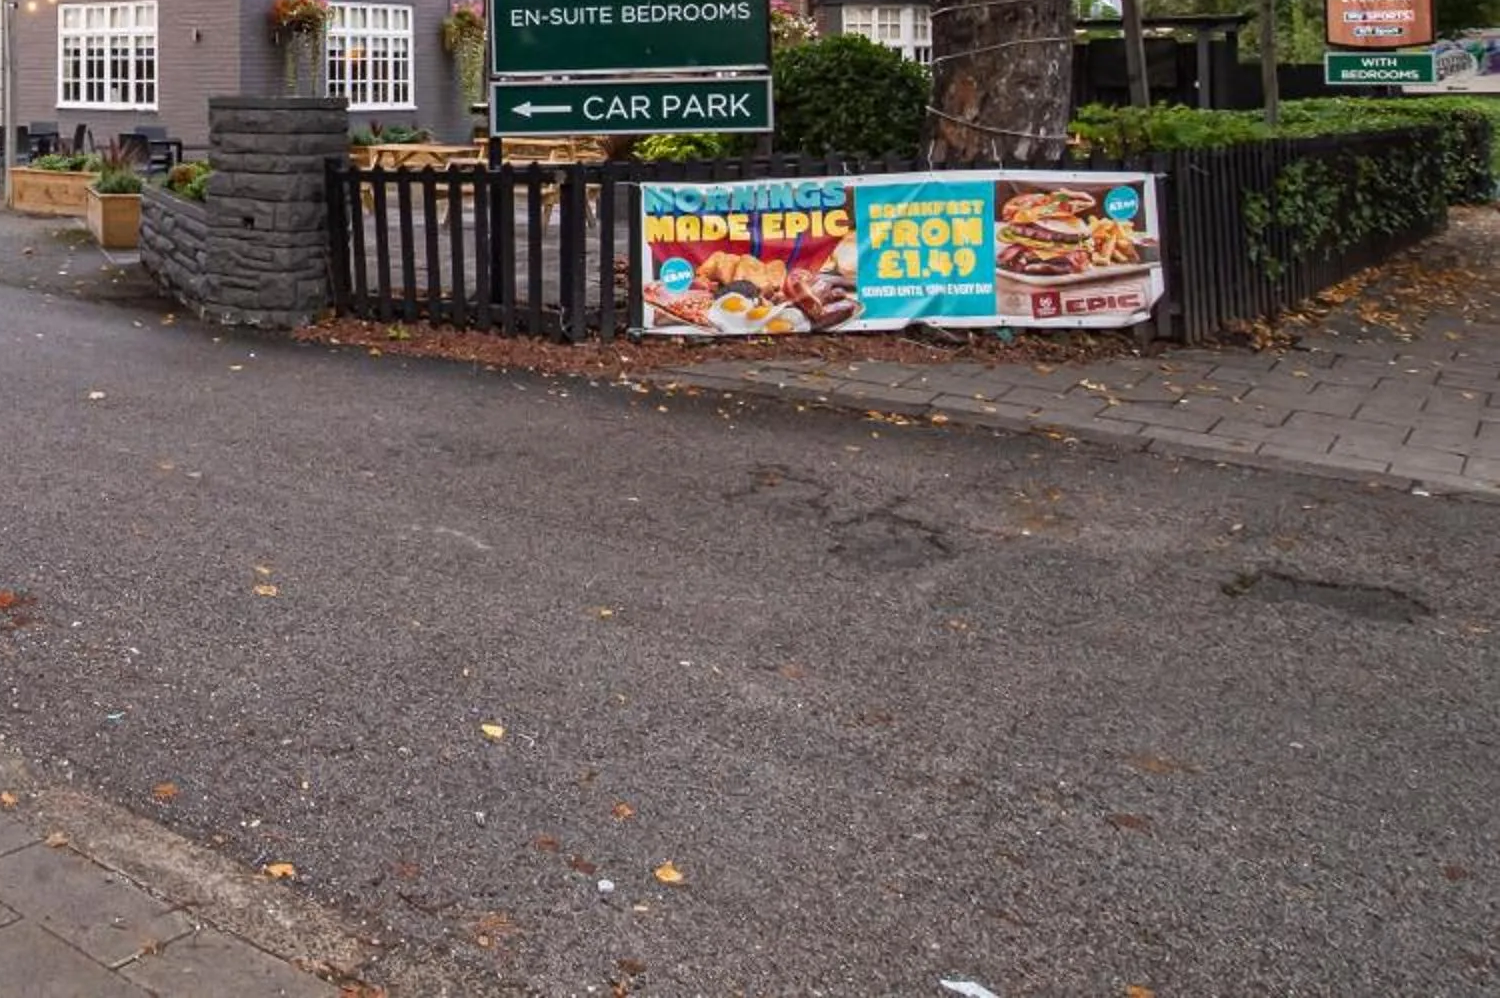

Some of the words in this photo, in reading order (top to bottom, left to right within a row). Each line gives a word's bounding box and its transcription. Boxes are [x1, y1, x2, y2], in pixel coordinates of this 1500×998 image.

[510, 6, 613, 27] EN-SUITE
[621, 2, 751, 23] BEDROOMS
[1341, 69, 1420, 80] BEDROOMS
[1361, 57, 1398, 67] WITH
[583, 95, 651, 120] CAR
[662, 93, 751, 119] PARK
[645, 213, 750, 243] MADE
[762, 210, 850, 239] EPIC
[869, 217, 983, 250] FROM
[877, 247, 977, 279] £1.49
[1065, 293, 1142, 313] EPIC
